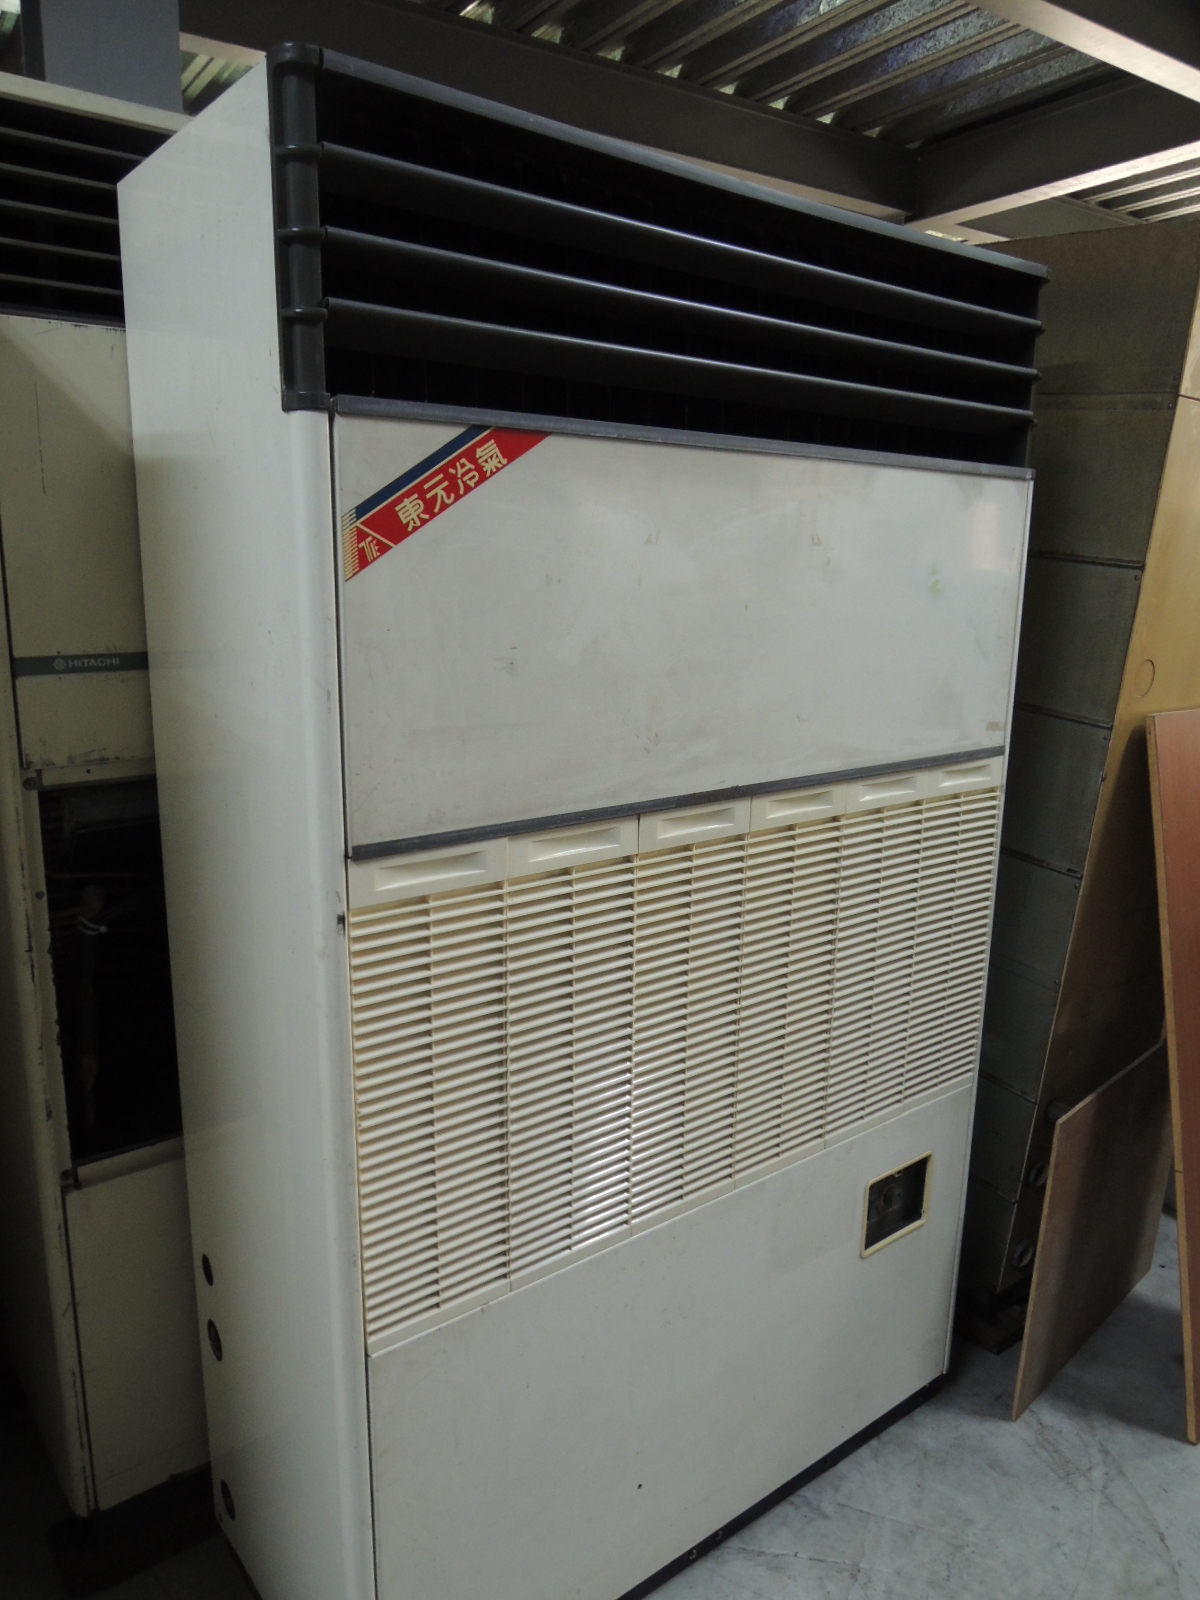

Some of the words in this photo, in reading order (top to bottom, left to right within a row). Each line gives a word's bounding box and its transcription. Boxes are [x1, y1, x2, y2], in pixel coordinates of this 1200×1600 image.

[395, 439, 508, 532] 東元冷氣
[67, 657, 121, 668] HITACHI
